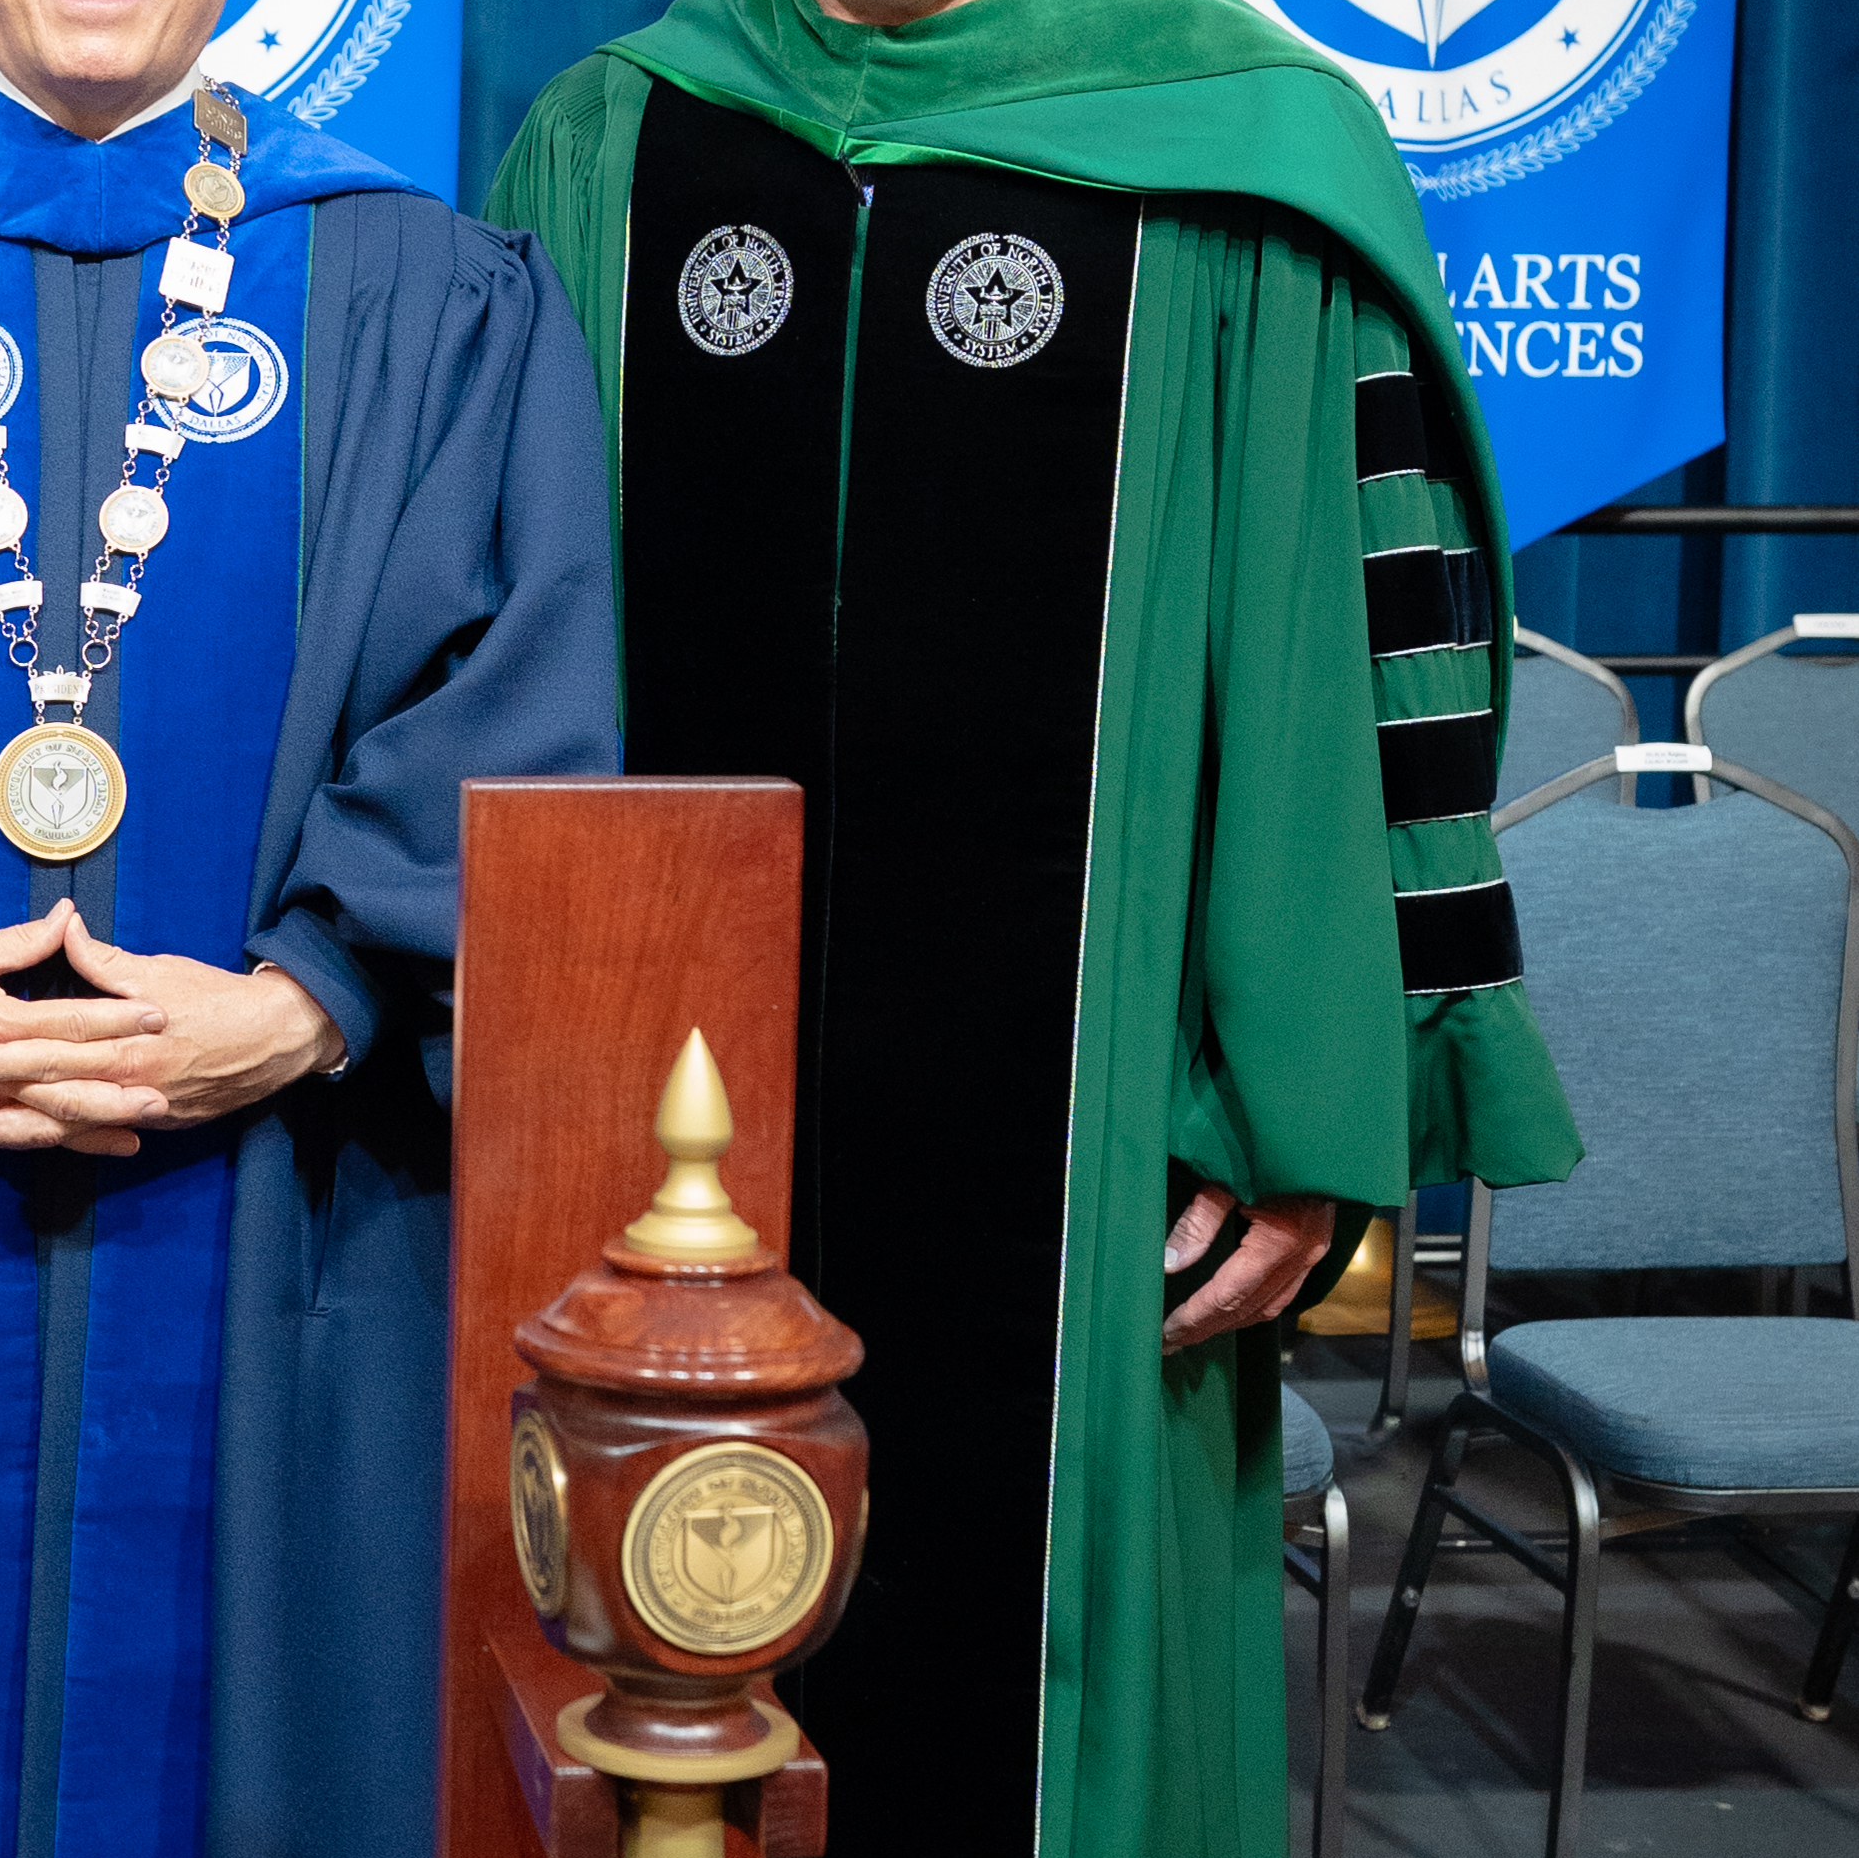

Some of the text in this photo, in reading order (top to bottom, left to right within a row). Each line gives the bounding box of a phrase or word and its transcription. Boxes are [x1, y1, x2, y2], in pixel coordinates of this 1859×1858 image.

[1377, 70, 1511, 123] ALLAS
[722, 235, 739, 248] OF
[938, 243, 1053, 337] UNIVERSITY OF NORTH TEXAS
[1463, 252, 1641, 310] ARTS
[190, 415, 241, 428] DALLAS
[33, 682, 86, 695] PRSIDENT
